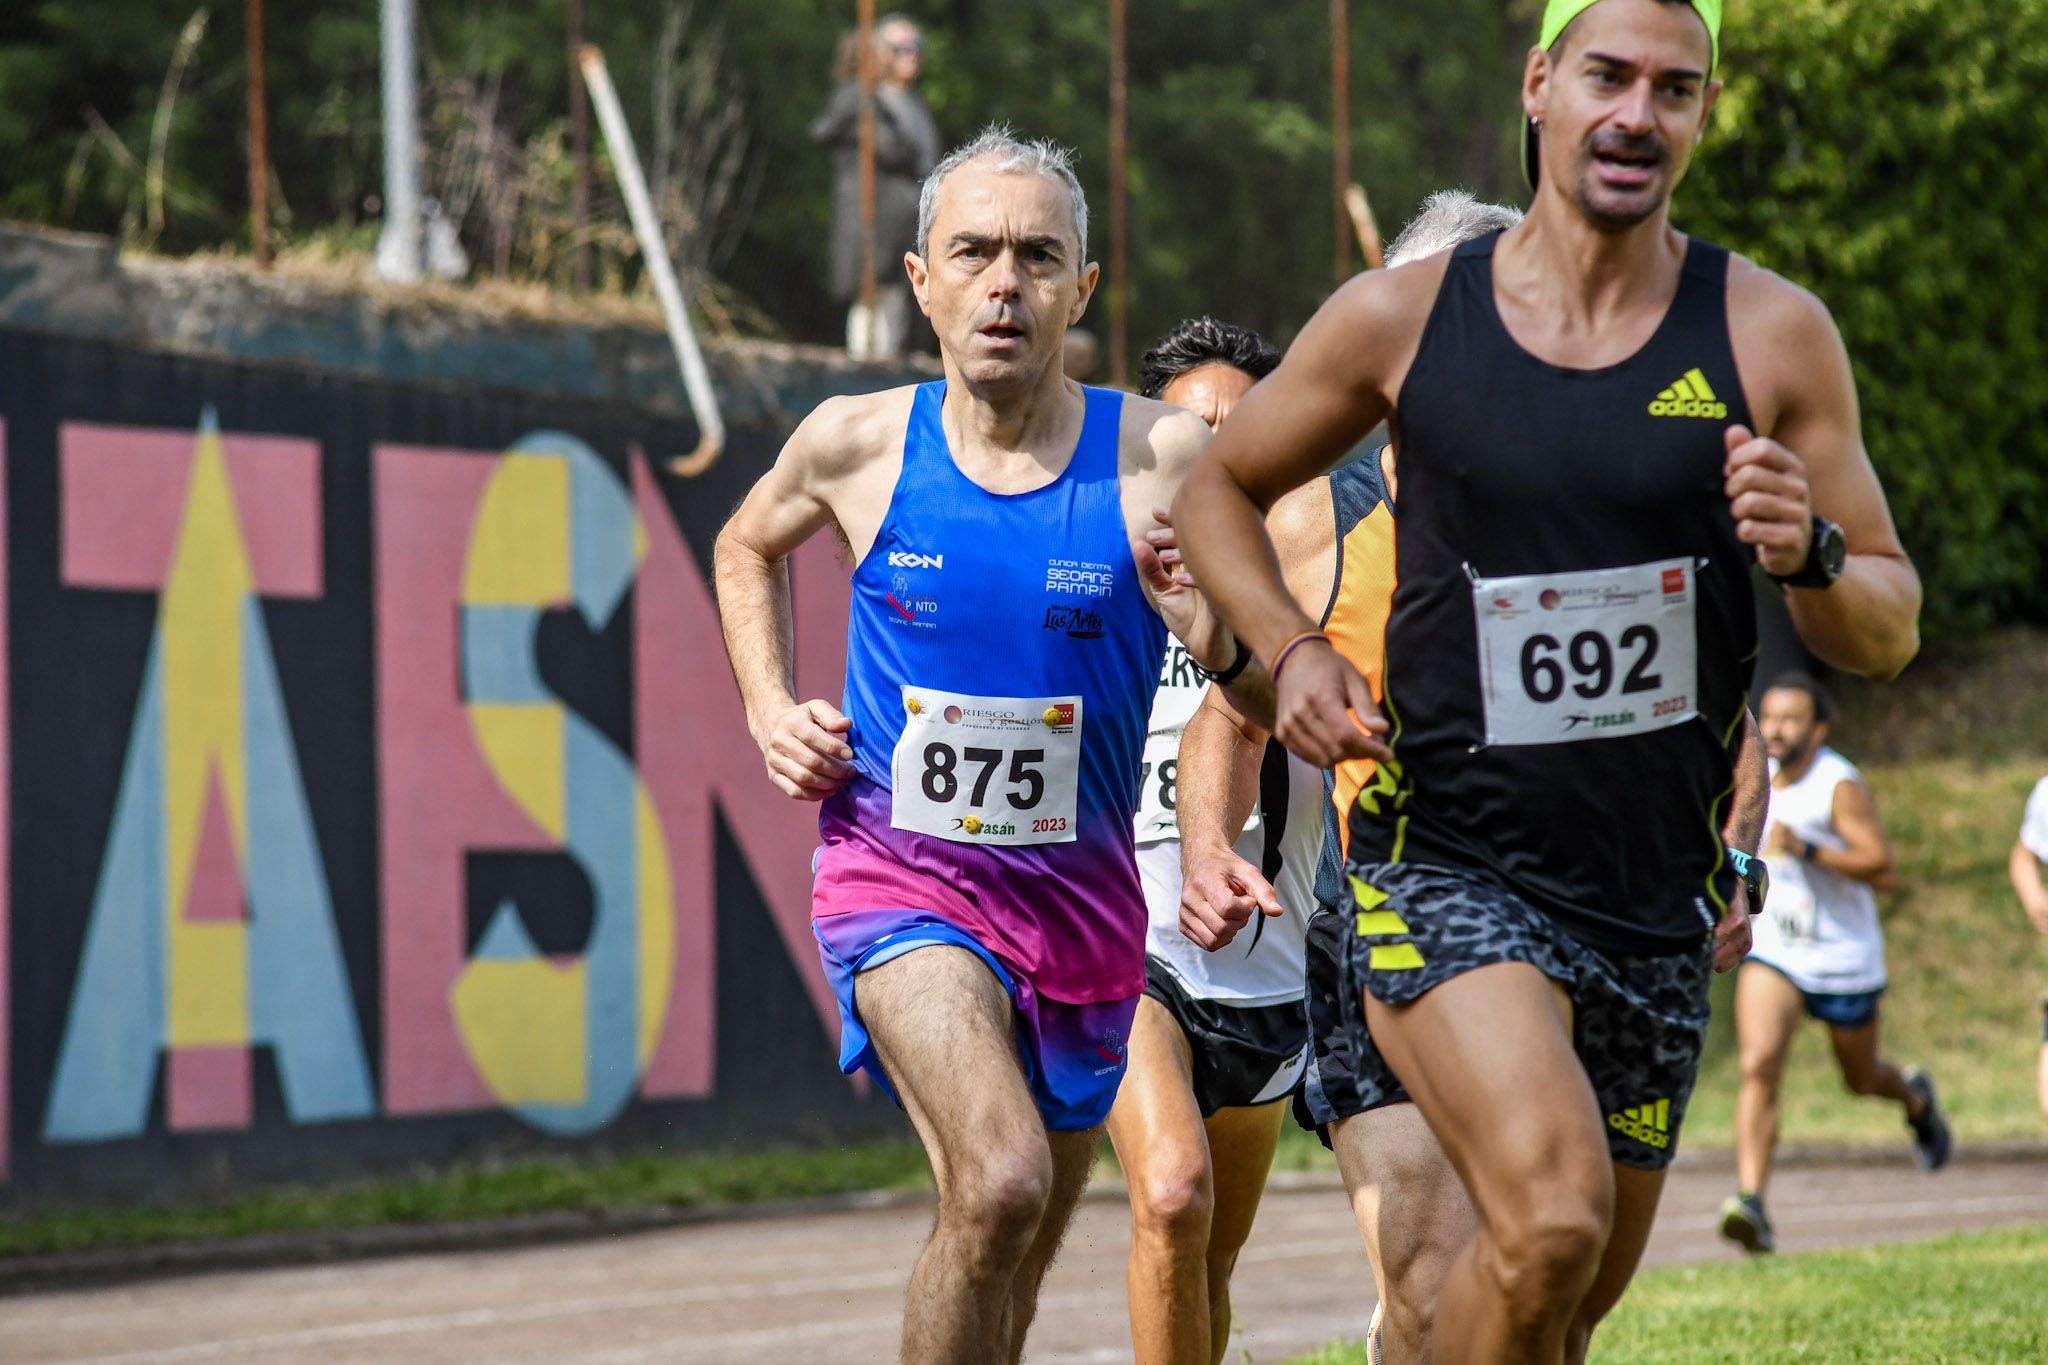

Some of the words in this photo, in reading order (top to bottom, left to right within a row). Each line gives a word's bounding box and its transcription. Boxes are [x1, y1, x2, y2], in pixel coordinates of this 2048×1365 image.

[1647, 399, 1727, 420] adidas
[1047, 568, 1113, 585] SEOANE
[1045, 580, 1112, 598] PAMPIN
[1520, 624, 1663, 704] 692
[921, 741, 1045, 810] 875
[1032, 817, 1067, 833] 2023
[1608, 1113, 1670, 1149] adidas
